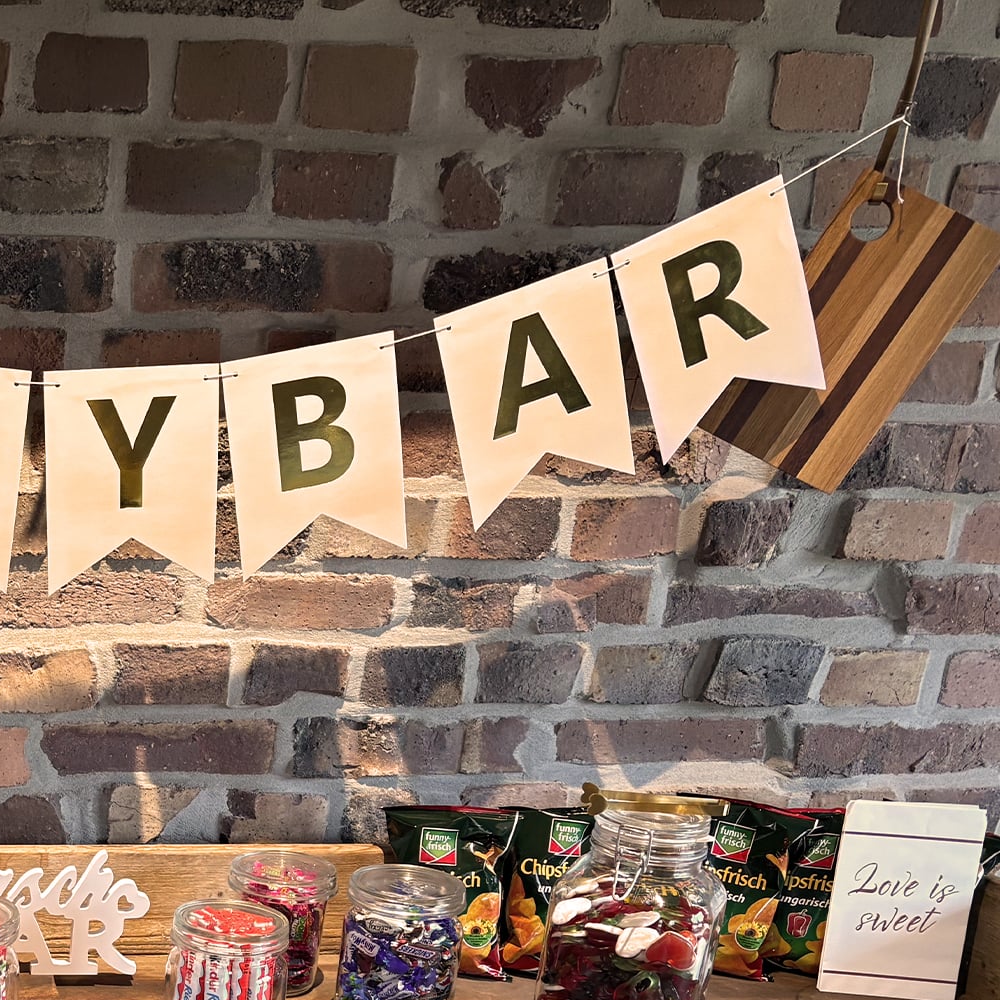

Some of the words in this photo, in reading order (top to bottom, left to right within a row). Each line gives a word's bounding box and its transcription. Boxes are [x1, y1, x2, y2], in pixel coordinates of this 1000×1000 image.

[425, 831, 451, 844] funny-
[720, 825, 748, 841] funny-
[721, 836, 746, 849] frisch
[428, 841, 452, 851] frisch
[520, 858, 570, 880] Chipsf
[784, 870, 834, 892] ipsfris
[847, 862, 920, 897] Love
[929, 875, 960, 903] is
[854, 907, 942, 935] sweet
[12, 906, 137, 976] AR
